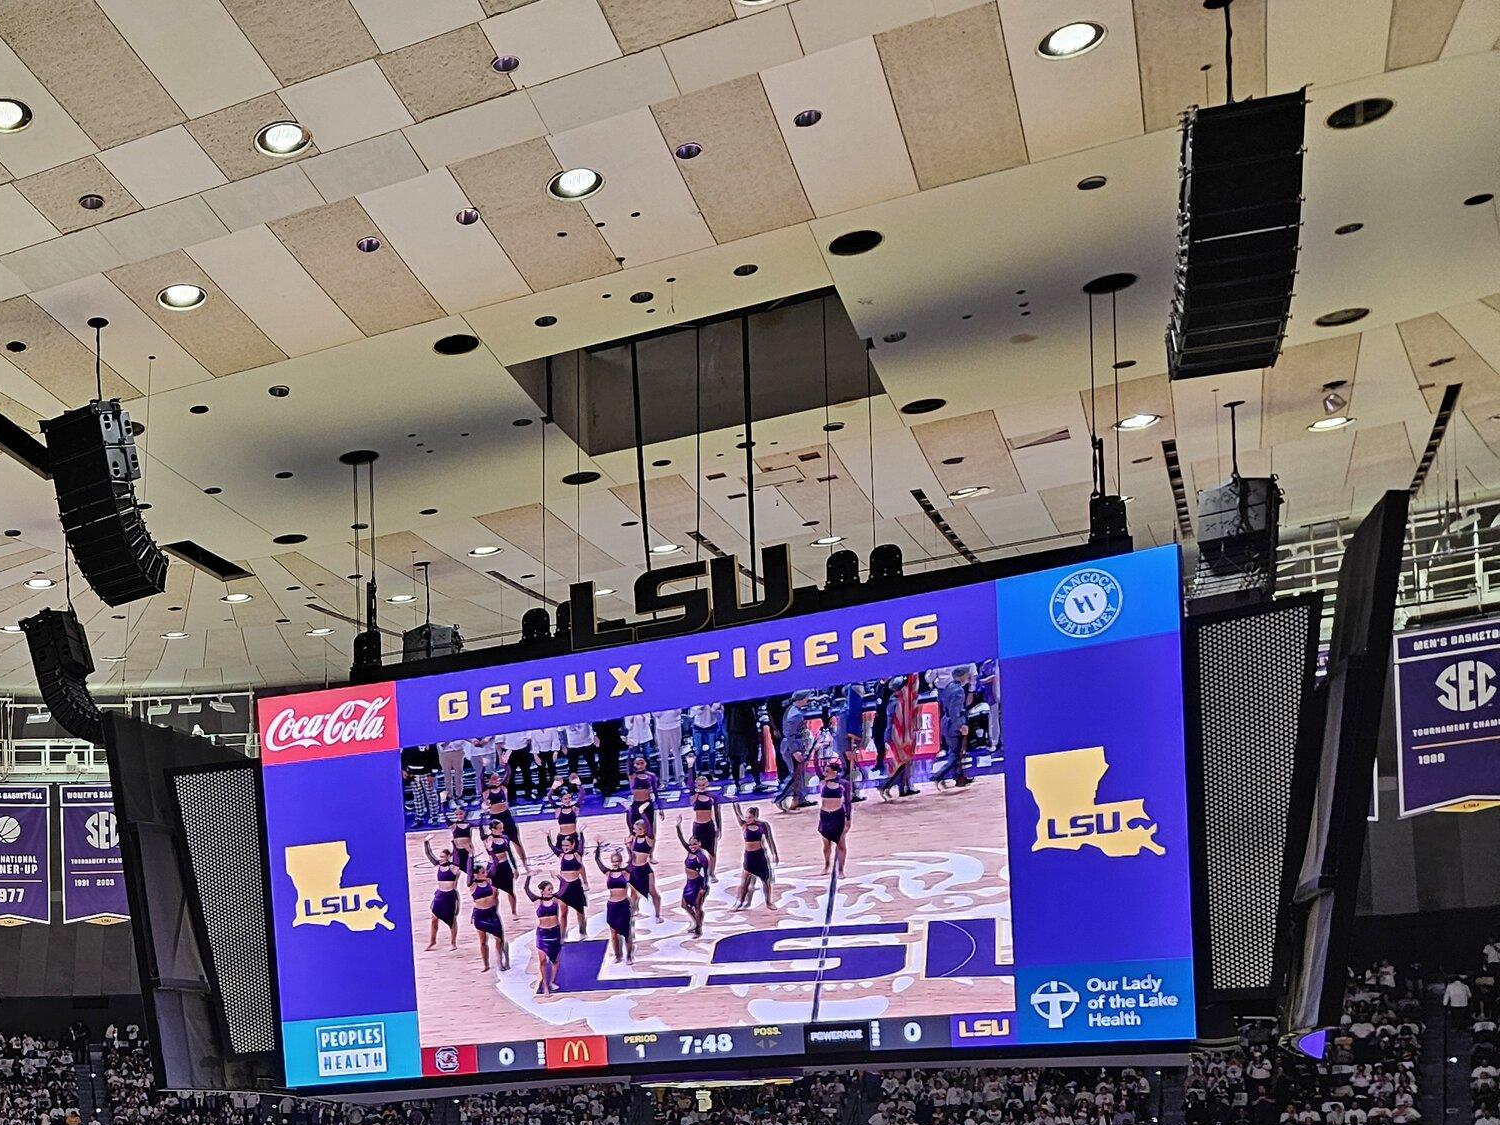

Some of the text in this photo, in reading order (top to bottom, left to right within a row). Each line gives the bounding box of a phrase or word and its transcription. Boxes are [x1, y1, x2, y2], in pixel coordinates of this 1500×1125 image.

[569, 543, 794, 651] LSU
[1055, 573, 1116, 603] HANCOCK
[1057, 603, 1116, 634] WHITNEY
[1413, 637, 1448, 651] MEN'S
[438, 614, 938, 723] GEAUX TIGERS
[1435, 660, 1497, 711] SEC
[266, 696, 391, 751] Coca-Cola
[1412, 722, 1470, 737] TOURNAMENT
[67, 791, 98, 799] WOMEN'S
[85, 811, 120, 849] SEC
[1048, 811, 1123, 840] LSU
[0, 856, 37, 864] NATIONAL
[304, 894, 362, 917] LSU
[1086, 974, 1163, 993] Our Lady
[1087, 990, 1180, 1010] of the Lake
[958, 1018, 1010, 1038] LSU
[1088, 1011, 1142, 1027] Health
[320, 1028, 382, 1048] PEOPLES
[623, 1033, 658, 1044] PERIOD
[753, 1026, 782, 1037] POSS.
[810, 1029, 864, 1042] POWERADE
[904, 1022, 922, 1042] 0
[635, 1044, 646, 1058] 1
[679, 1034, 734, 1055] 7:48
[323, 1052, 384, 1071] HEALTH
[499, 1047, 515, 1065] 0
